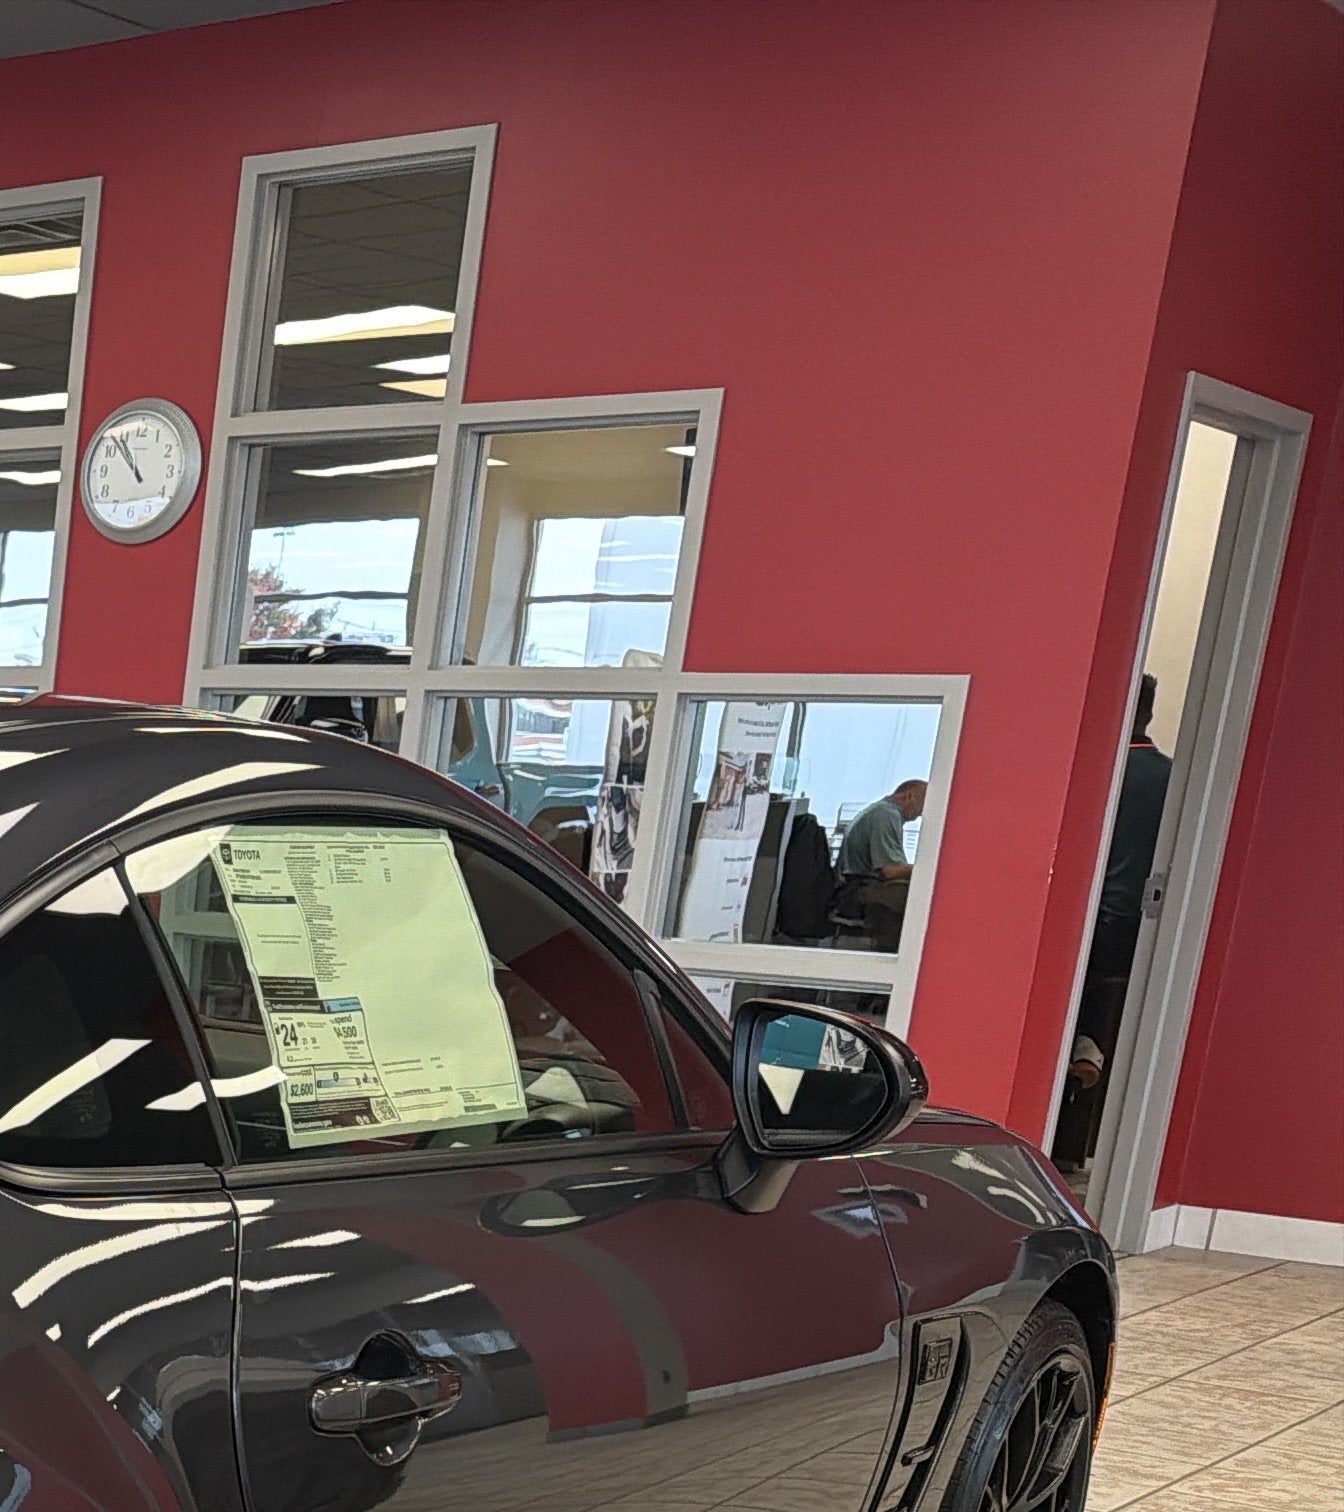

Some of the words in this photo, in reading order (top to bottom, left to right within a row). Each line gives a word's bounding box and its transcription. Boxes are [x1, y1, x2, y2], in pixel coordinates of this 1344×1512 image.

[136, 424, 148, 437] 12
[156, 429, 160, 442] 1
[105, 445, 116, 458] 10
[164, 444, 172, 458] 2
[100, 464, 108, 478] 9
[166, 464, 174, 478] 3
[101, 484, 109, 497] 8
[158, 485, 166, 498] 4
[112, 500, 119, 513] 7
[127, 506, 134, 518] 6
[144, 500, 151, 513] 5
[234, 850, 261, 860] TOYOTA
[281, 1024, 298, 1047] 24
[291, 1083, 313, 1096] $2,600
